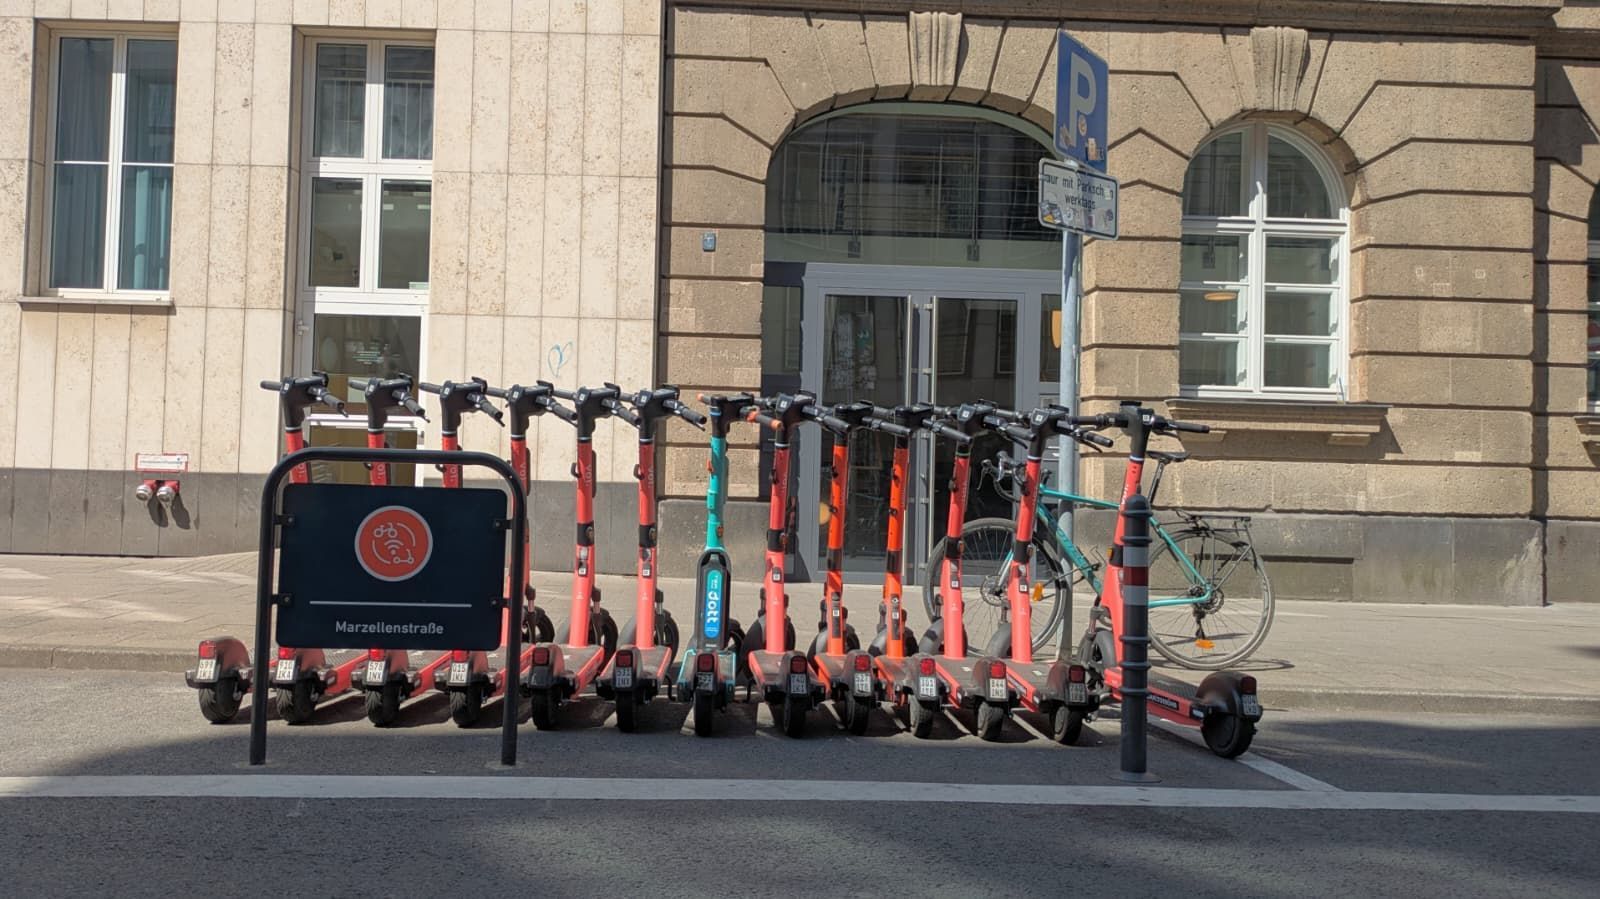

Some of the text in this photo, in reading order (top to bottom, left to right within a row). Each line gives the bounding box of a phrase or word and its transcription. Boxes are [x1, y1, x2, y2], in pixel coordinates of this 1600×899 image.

[1069, 52, 1097, 148] P
[1062, 176, 1074, 188] mit
[1077, 178, 1114, 200] Parkschn
[1065, 194, 1096, 213] werktags
[707, 591, 719, 624] dott
[335, 620, 444, 634] Marzellenstraße
